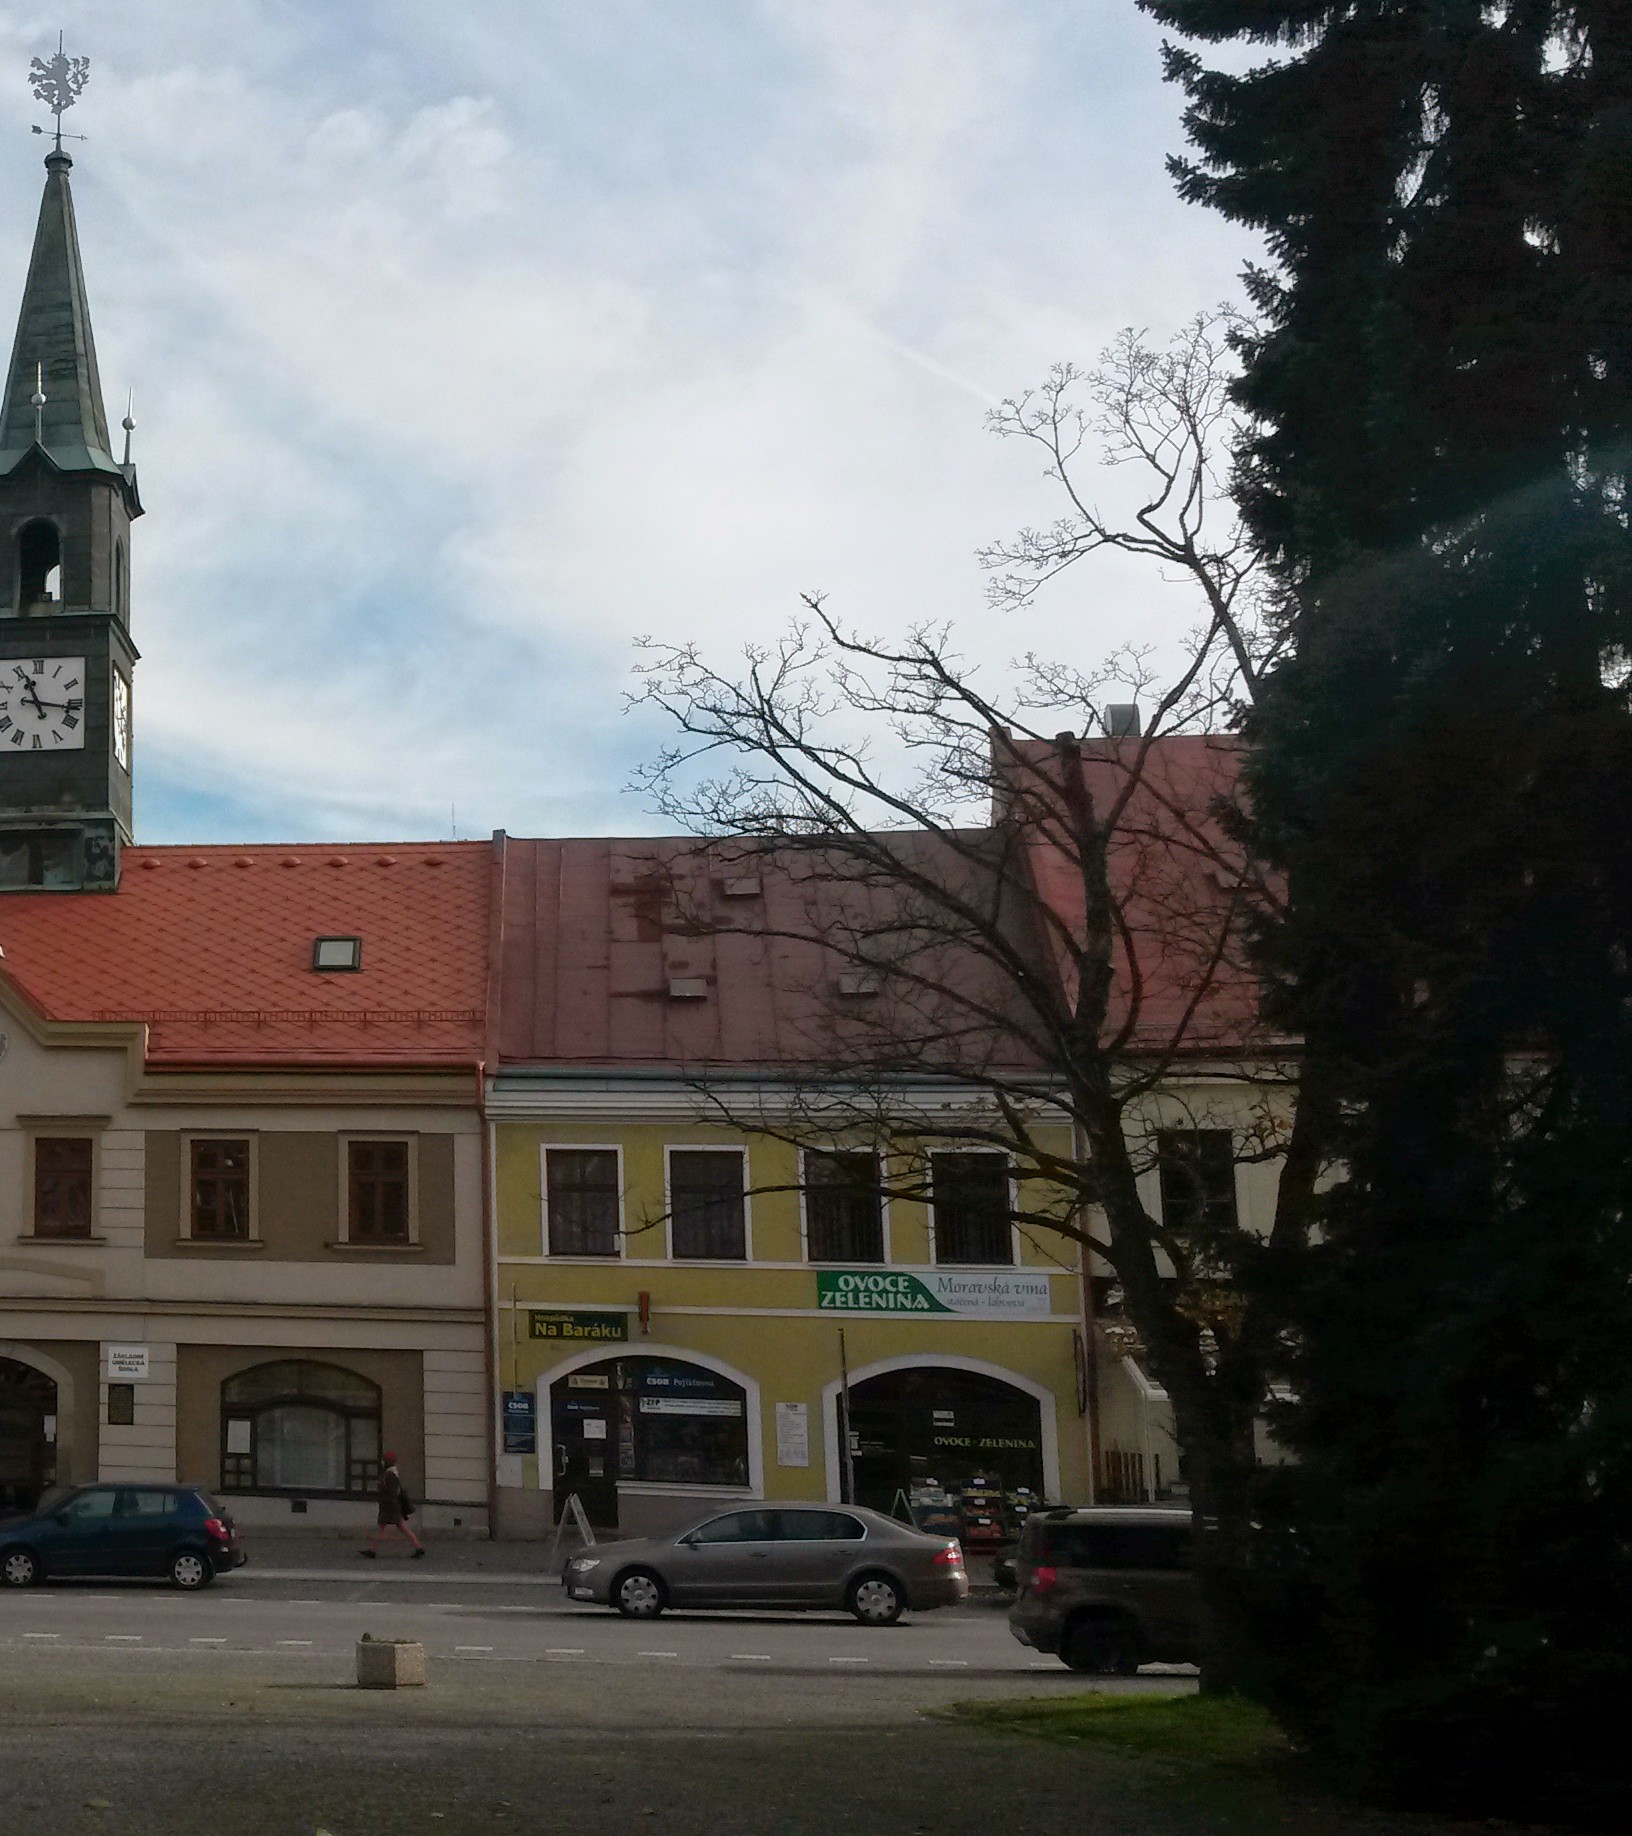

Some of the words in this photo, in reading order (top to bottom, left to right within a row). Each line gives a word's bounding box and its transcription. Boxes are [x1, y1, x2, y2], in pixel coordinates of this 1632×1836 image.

[32, 660, 44, 674] XII
[52, 665, 62, 678] I
[63, 678, 79, 690] II
[52, 730, 64, 744] V
[837, 1275, 911, 1293] OVOCE
[936, 1276, 1009, 1295] Moravská
[820, 1291, 930, 1309] ZELENINA
[535, 1322, 557, 1336] Na
[562, 1322, 622, 1338] Baráku
[934, 1436, 971, 1447] OVOCE
[979, 1437, 1036, 1449] ZELENINA
